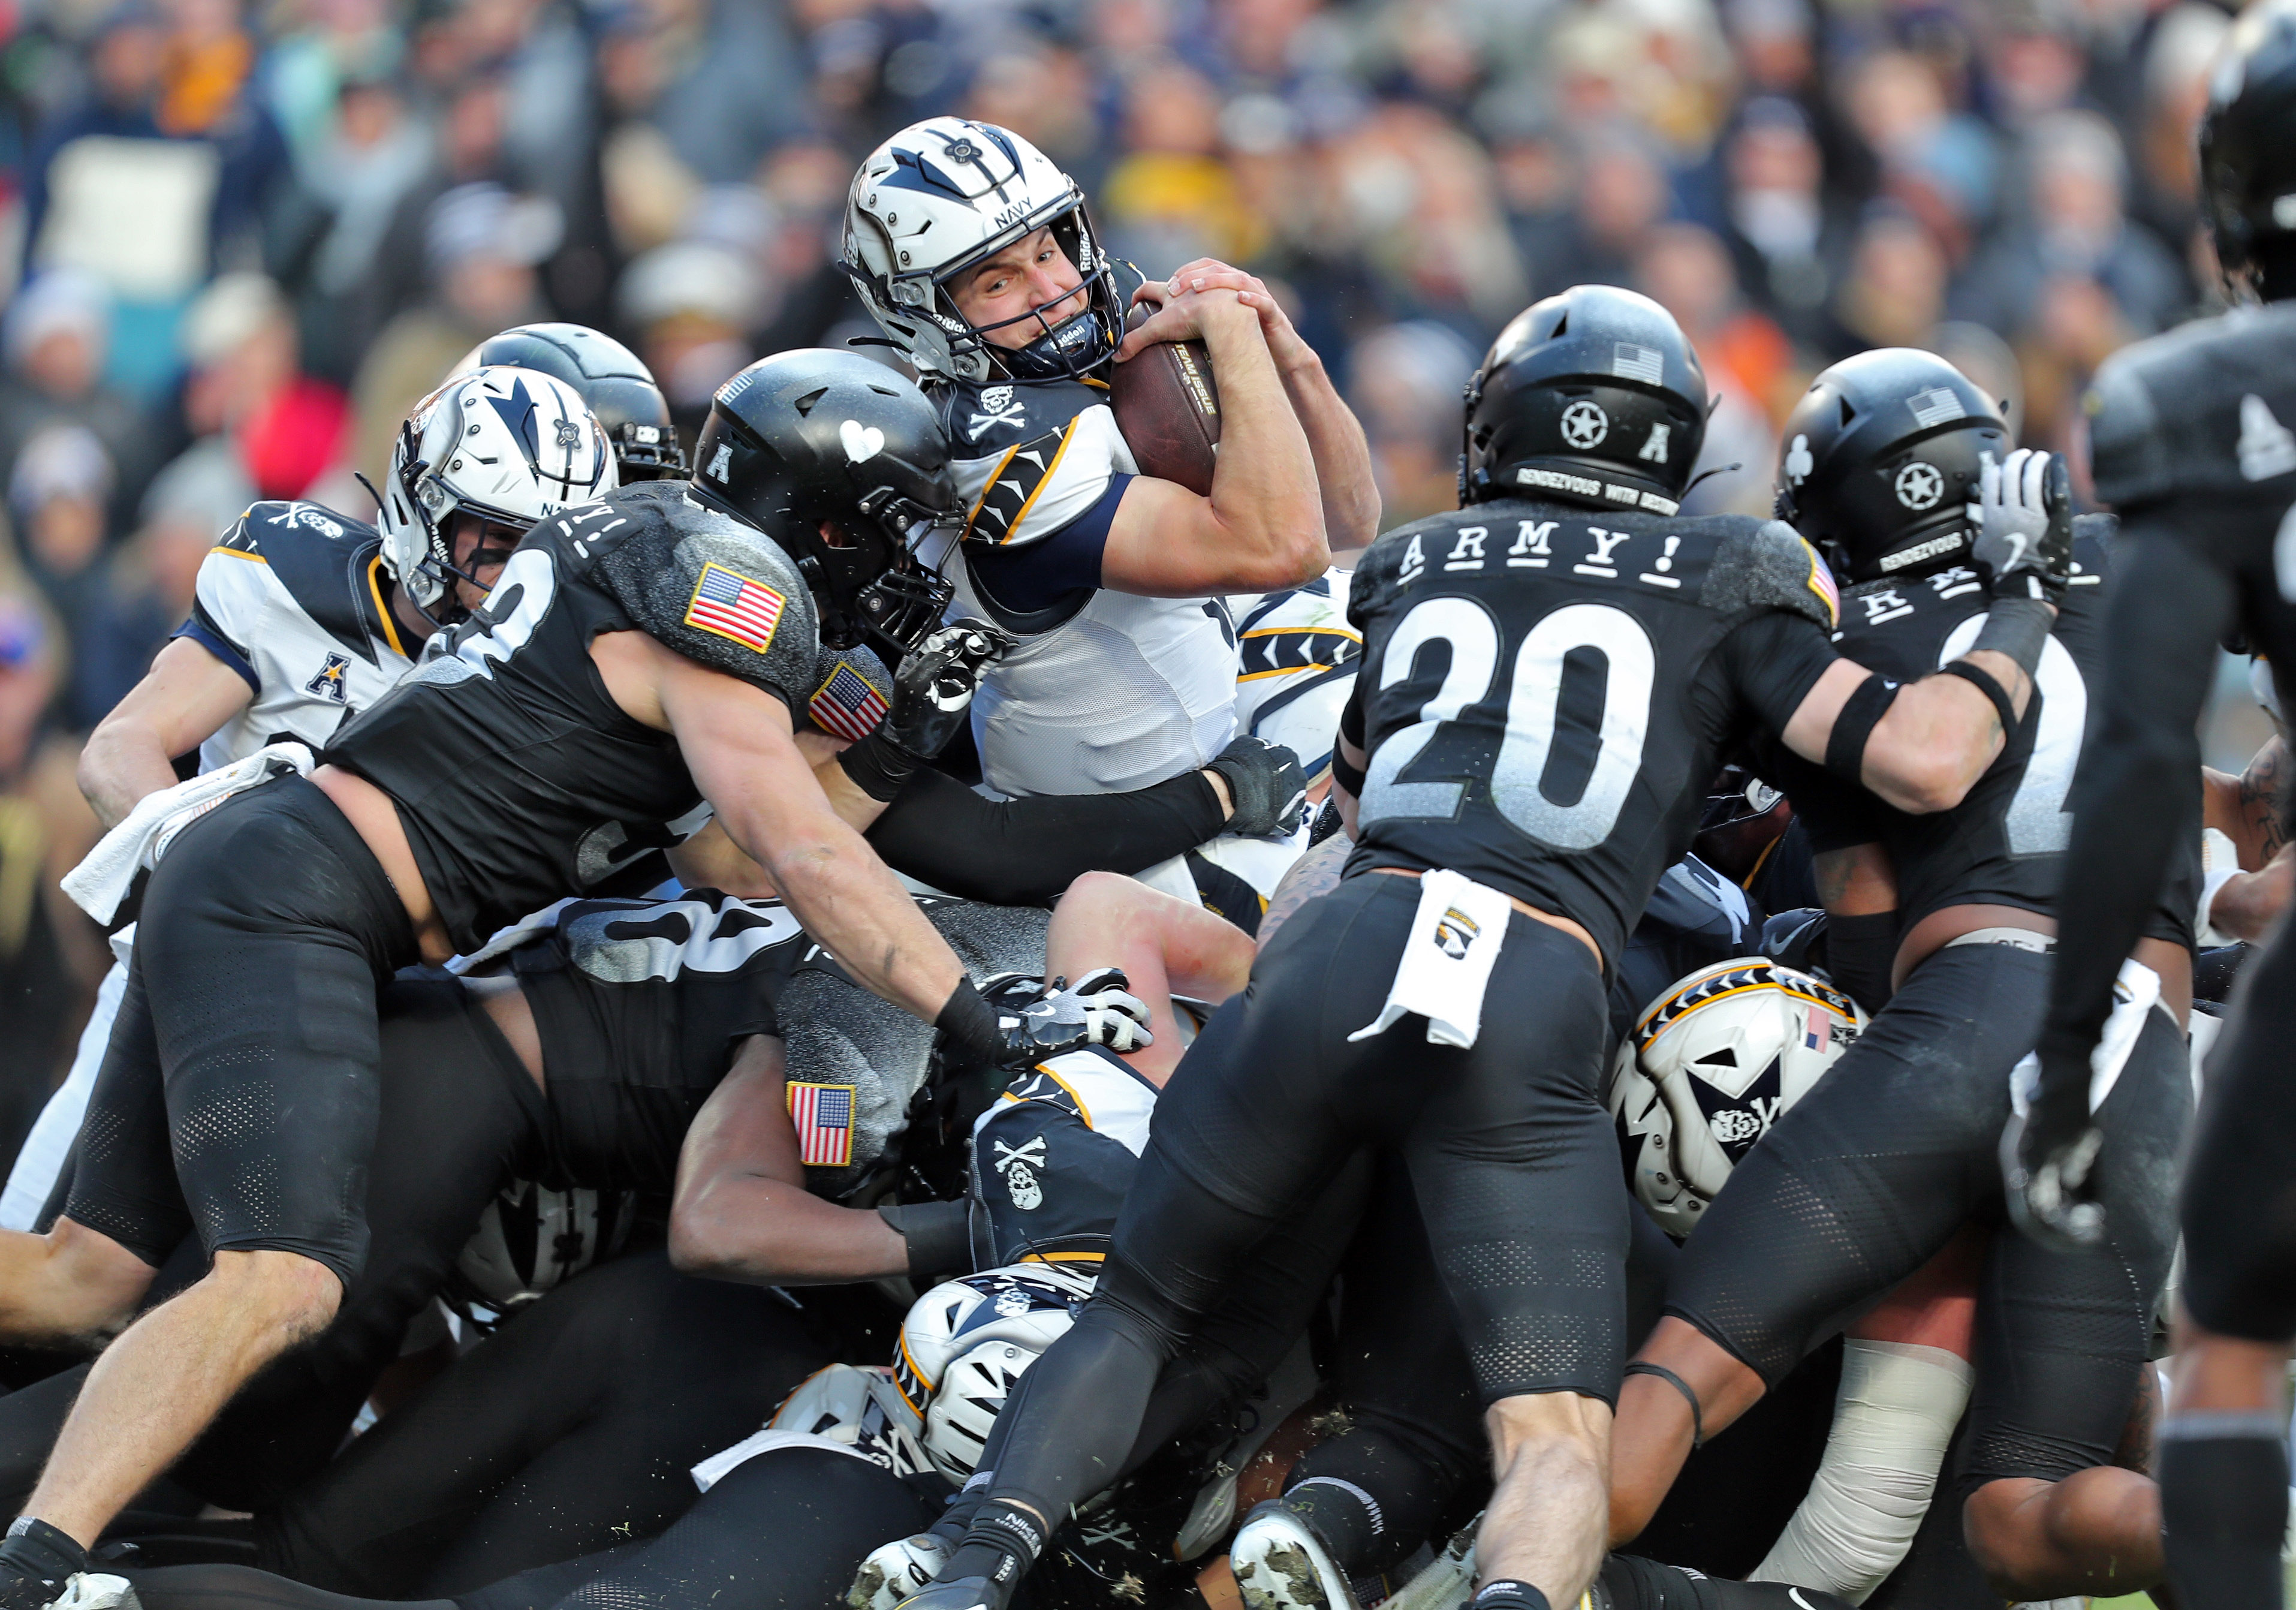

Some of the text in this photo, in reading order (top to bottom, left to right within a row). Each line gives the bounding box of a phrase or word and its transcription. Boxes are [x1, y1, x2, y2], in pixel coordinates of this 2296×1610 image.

[994, 196, 1033, 229] NAVY
[1175, 343, 1218, 416] TEAM ISSUE
[1516, 468, 1602, 496] RENDEZVOUS
[1604, 483, 1640, 505] WITH
[1879, 531, 1963, 573] RENDEZVOUS
[1358, 597, 1657, 850] 20
